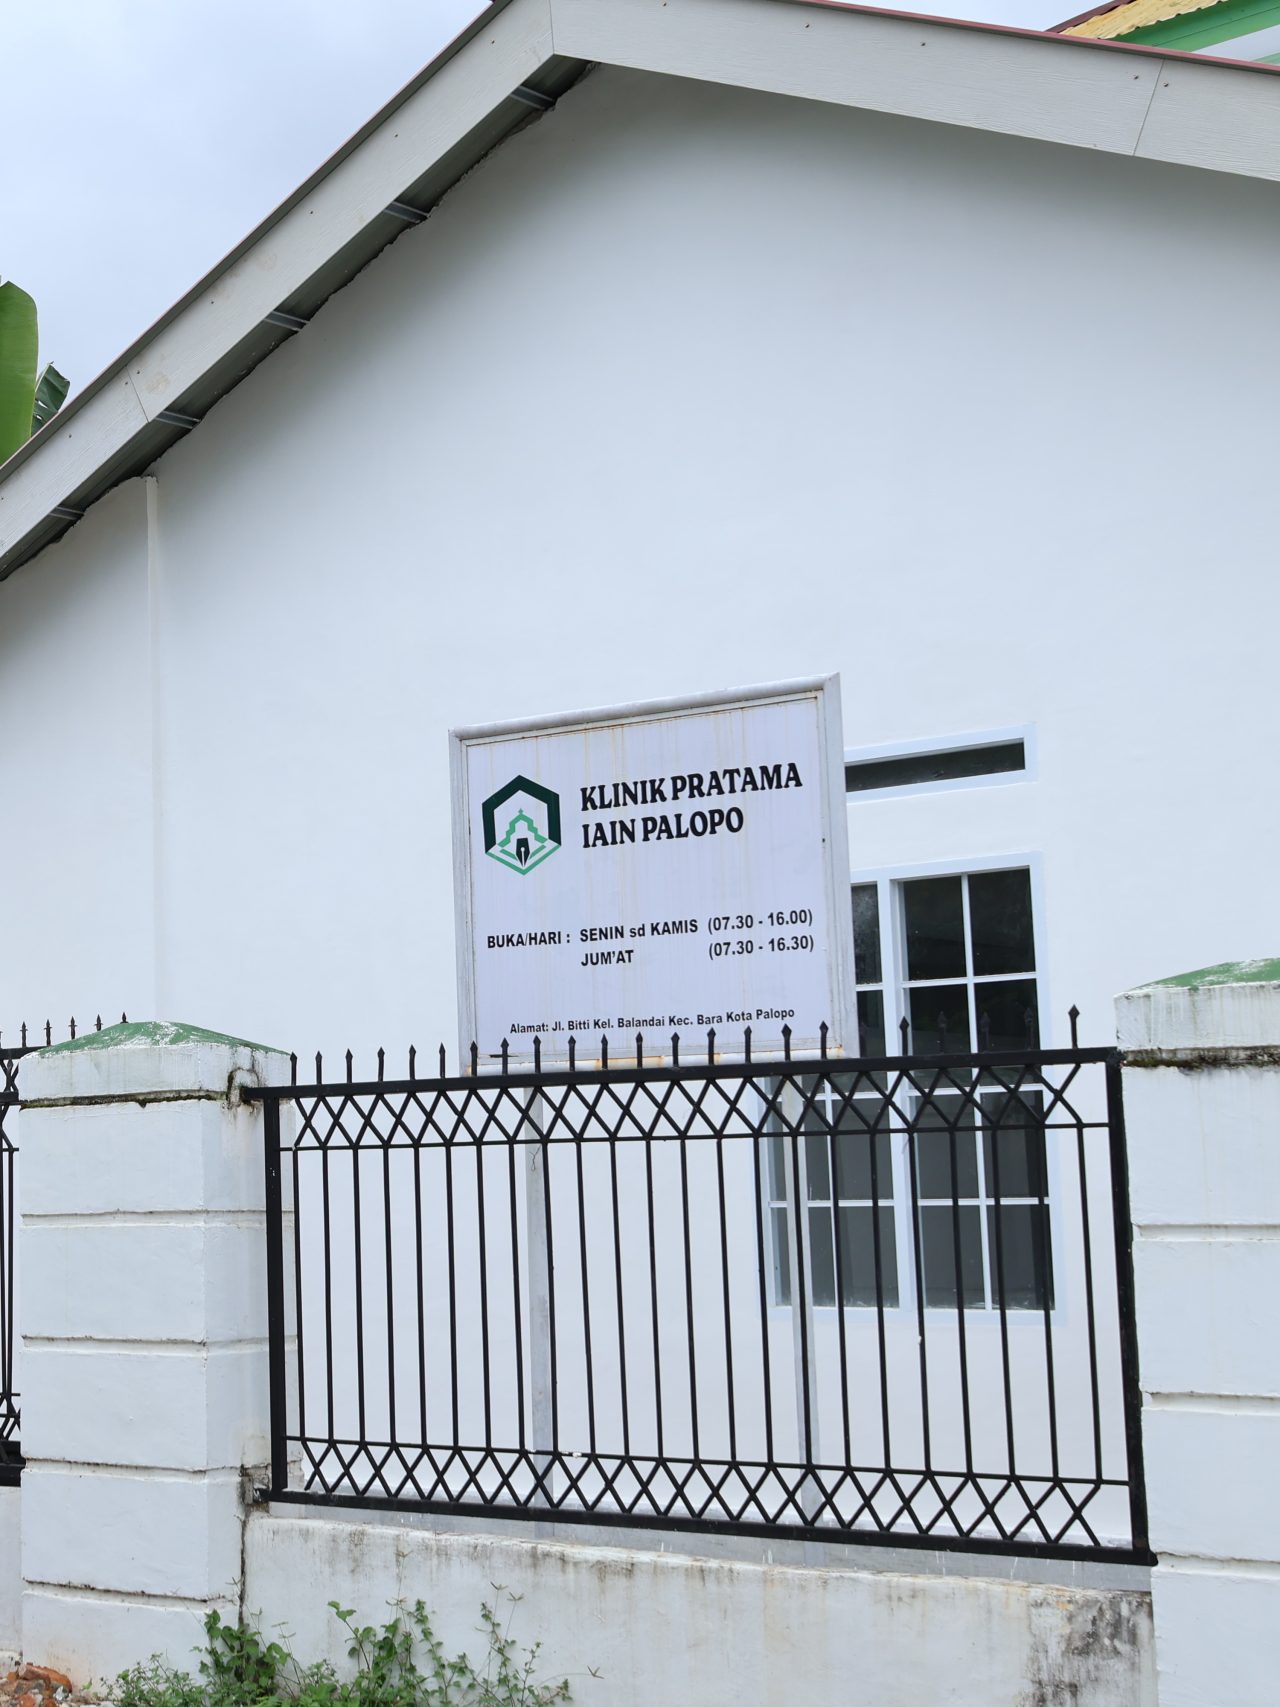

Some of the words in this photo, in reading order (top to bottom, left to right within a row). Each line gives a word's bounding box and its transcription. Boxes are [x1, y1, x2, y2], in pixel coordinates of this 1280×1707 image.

[580, 777, 667, 812] KLINIK
[670, 762, 803, 800] PRATAMA
[582, 818, 637, 849] IAIN
[641, 806, 744, 842] PALOPO
[487, 931, 562, 949] BUKA/HARI
[579, 925, 625, 943] SENIN
[629, 923, 646, 939] sd
[650, 919, 699, 937] KAMIS
[707, 914, 754, 935] (07.30
[767, 908, 813, 931] 16.00)
[708, 940, 755, 961] (07.30
[767, 934, 815, 957] 16.30)
[509, 1021, 549, 1034] Alamat:
[551, 1019, 565, 1032] Jl.
[567, 1019, 590, 1031] Bitti
[593, 1017, 614, 1030] Kel.
[617, 1015, 665, 1029] Balandai
[668, 1014, 693, 1027] Kec.
[696, 1013, 723, 1026] Bara
[726, 1010, 753, 1023] Kota
[756, 1007, 795, 1022] Palopo
